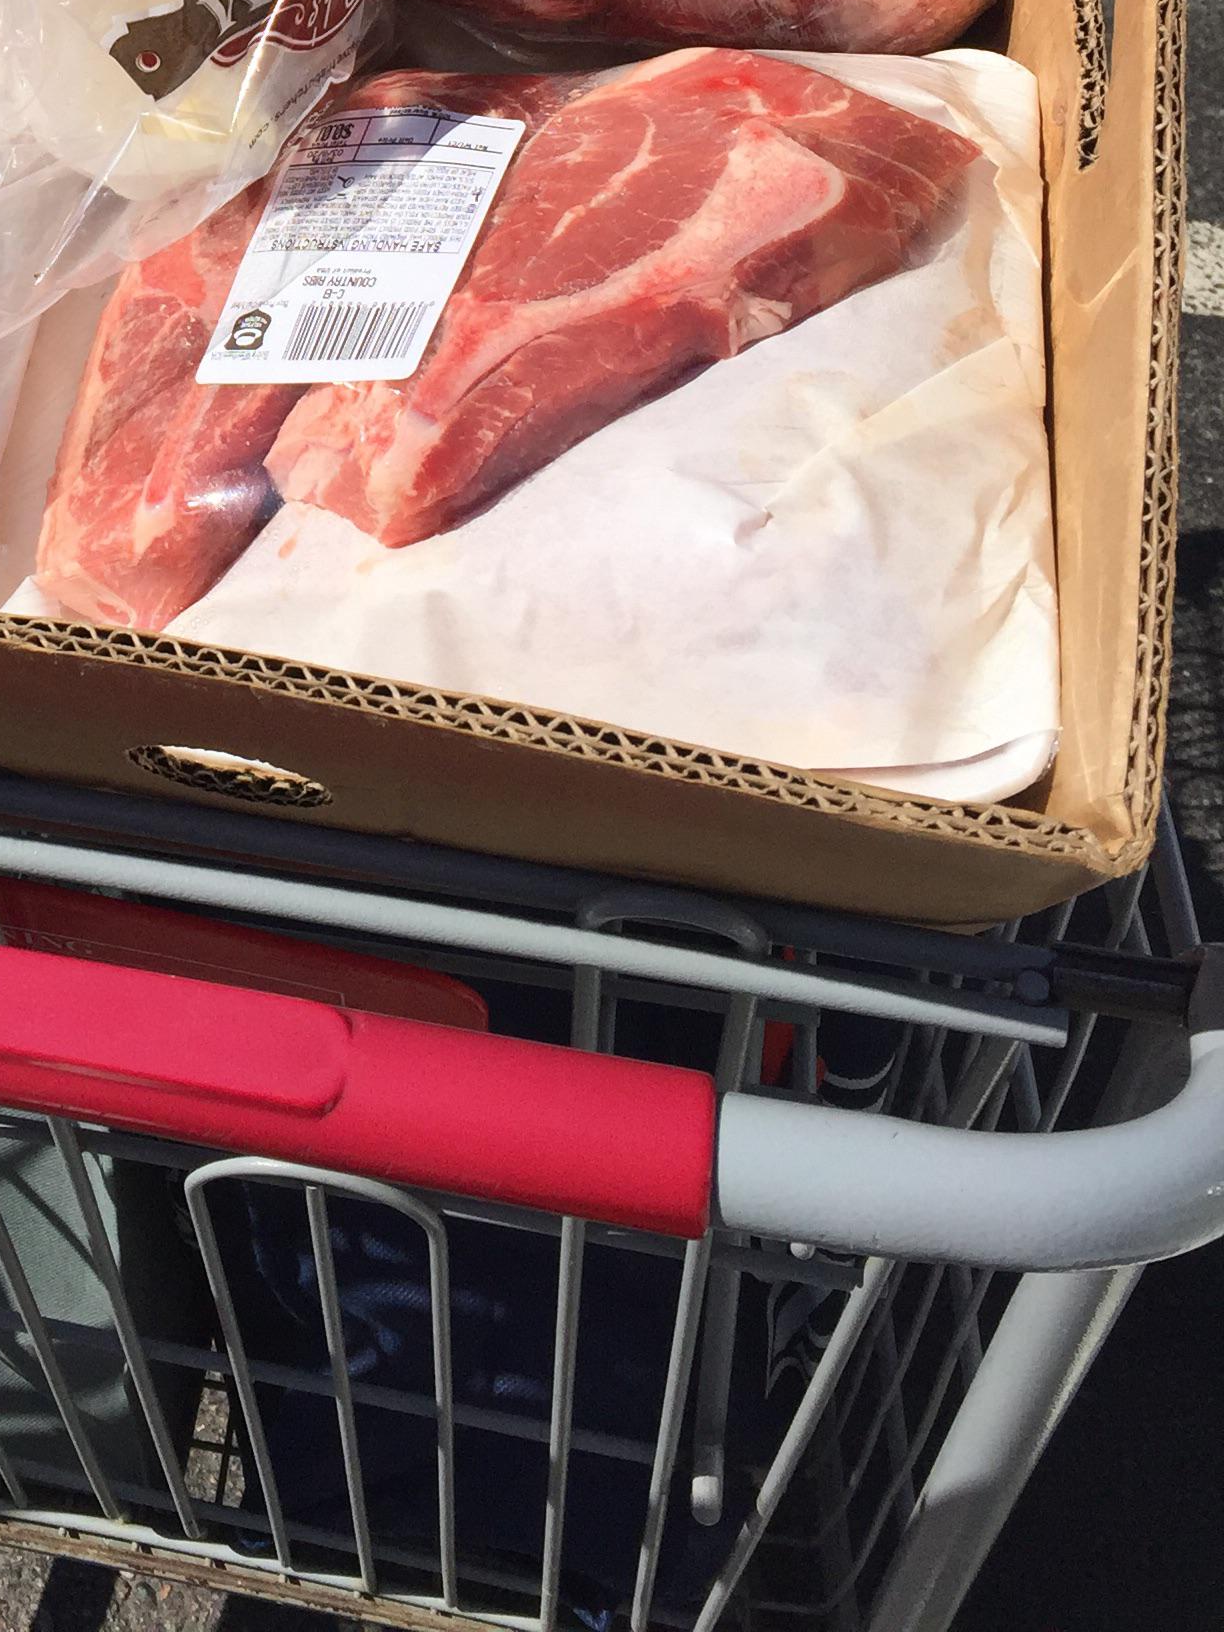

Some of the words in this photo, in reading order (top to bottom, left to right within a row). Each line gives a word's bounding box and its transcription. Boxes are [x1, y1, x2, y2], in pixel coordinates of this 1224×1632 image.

[270, 238, 348, 252] INSTRUCTIONS
[351, 239, 408, 252] HANDLING
[410, 240, 442, 253] SAFE
[302, 275, 326, 287] RIBS
[328, 276, 378, 288] COUNTRY
